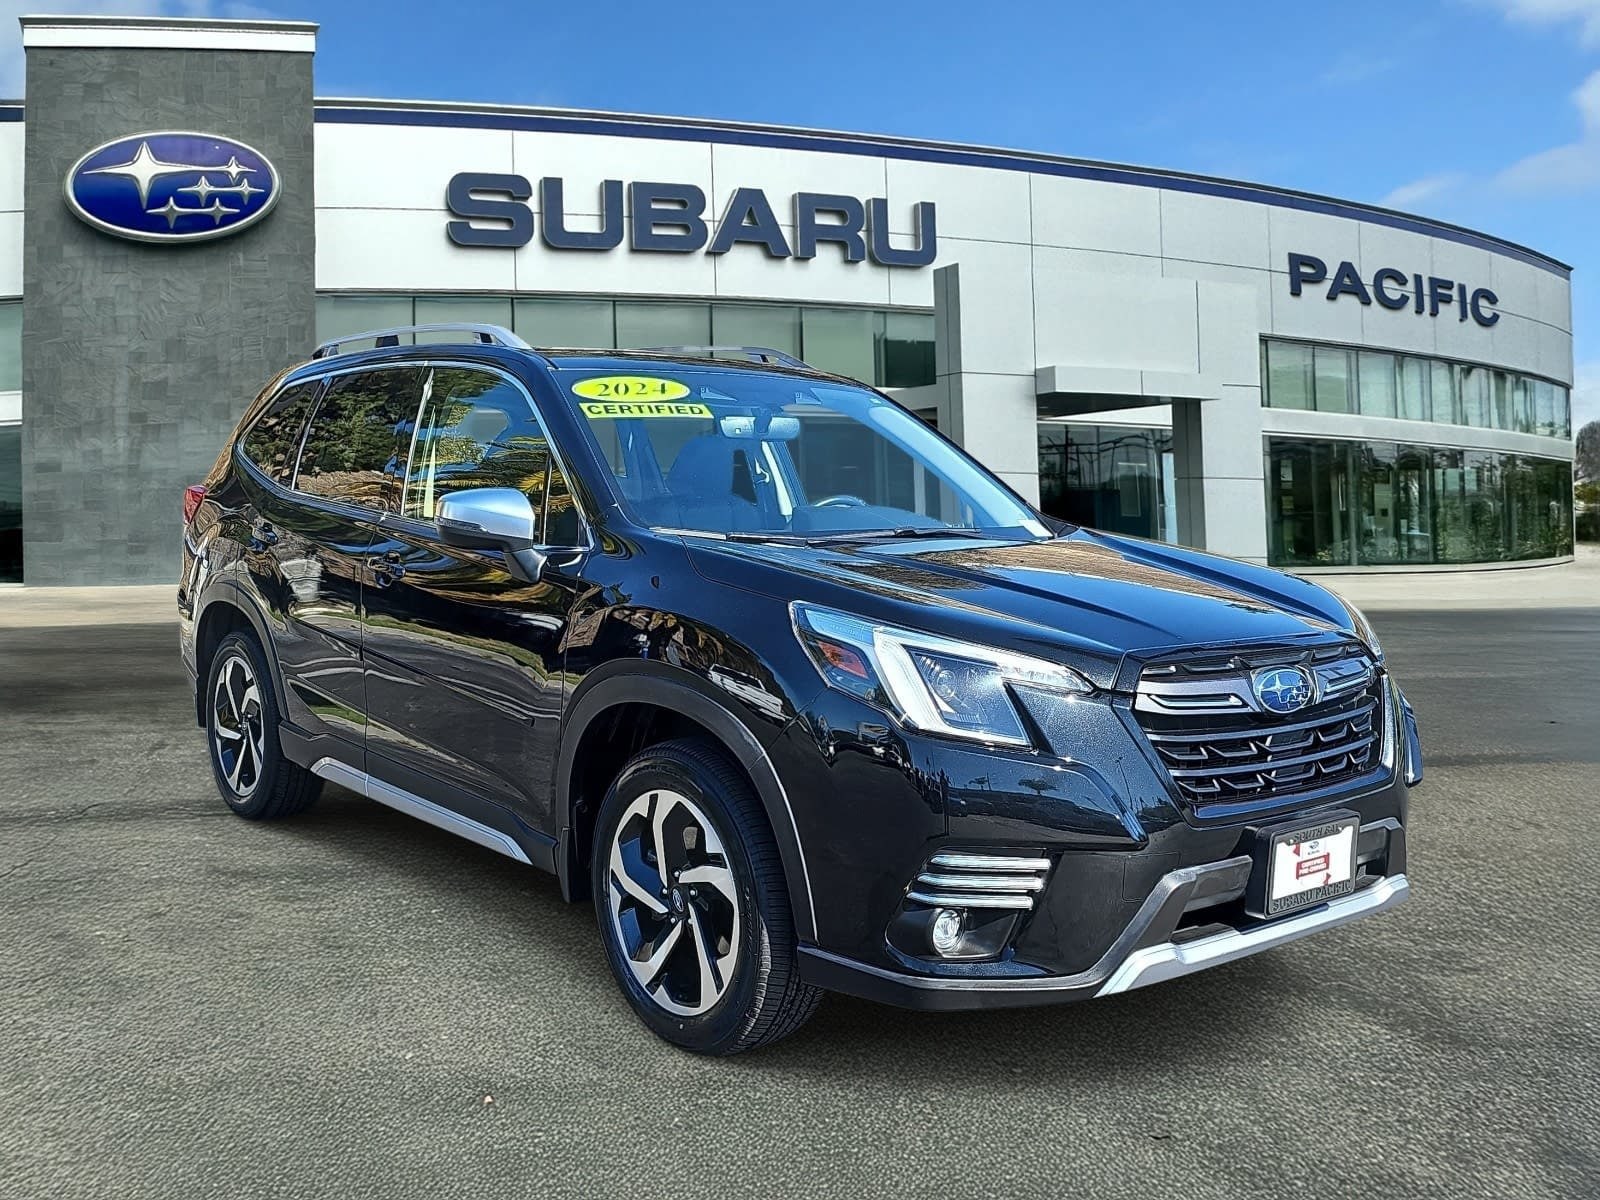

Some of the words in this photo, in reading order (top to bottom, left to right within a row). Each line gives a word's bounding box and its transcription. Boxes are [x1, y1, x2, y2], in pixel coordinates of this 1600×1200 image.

[446, 171, 937, 268] SUBARU
[1287, 252, 1500, 327] PACIFIC
[597, 382, 668, 397] 2024
[586, 404, 705, 416] CERTIFIED
[1294, 827, 1323, 841] SOUTH
[1272, 888, 1313, 912] SUBARU
[1315, 879, 1351, 899] PACIFIC
